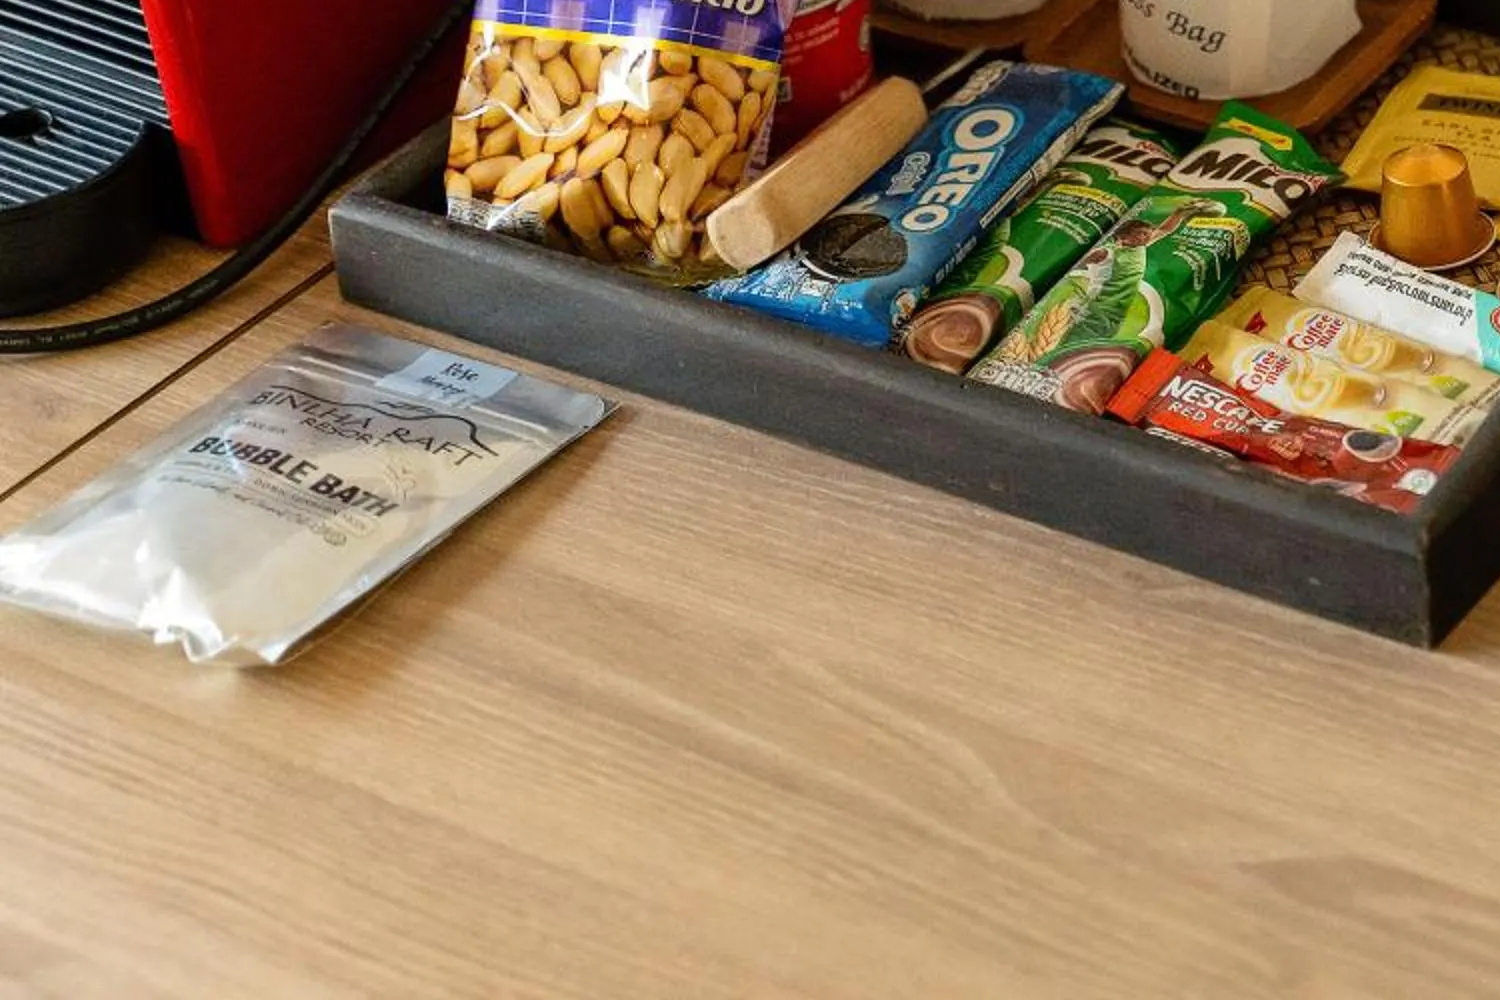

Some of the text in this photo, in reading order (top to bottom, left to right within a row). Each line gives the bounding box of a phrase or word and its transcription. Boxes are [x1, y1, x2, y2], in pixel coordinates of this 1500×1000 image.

[1166, 10, 1227, 53] Bag
[901, 107, 1016, 232] OREO
[1181, 149, 1309, 210] MILO
[1286, 313, 1333, 351] Coffee
[1237, 350, 1277, 392] Coffee
[1167, 401, 1207, 421] RED
[300, 418, 388, 447] RESORT
[388, 426, 483, 466] RAFT
[189, 437, 319, 485] BUBBLE
[310, 473, 400, 517] BATH
